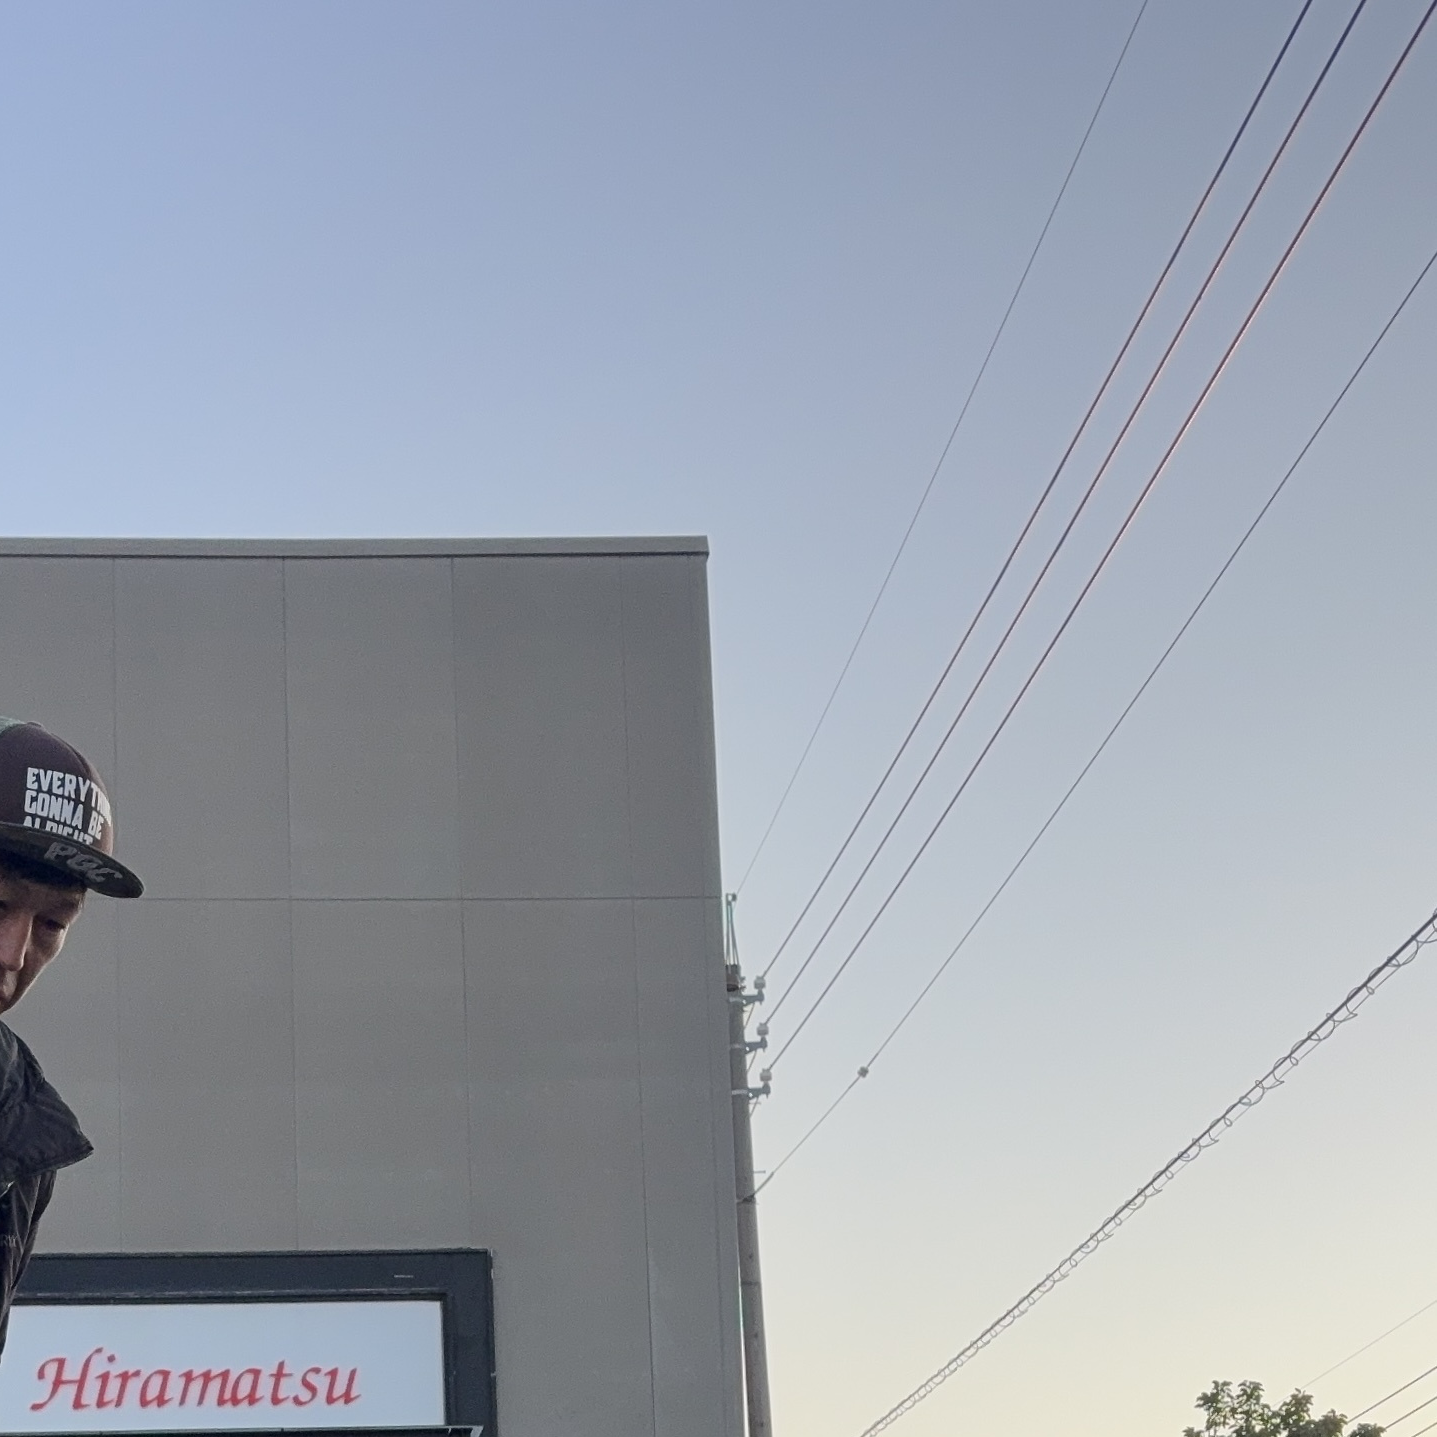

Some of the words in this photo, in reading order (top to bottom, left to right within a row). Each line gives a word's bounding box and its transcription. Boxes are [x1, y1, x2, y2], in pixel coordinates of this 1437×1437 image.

[24, 789, 84, 830] GONNA
[88, 810, 104, 840] BE
[29, 1346, 362, 1412] Hiramatsu
